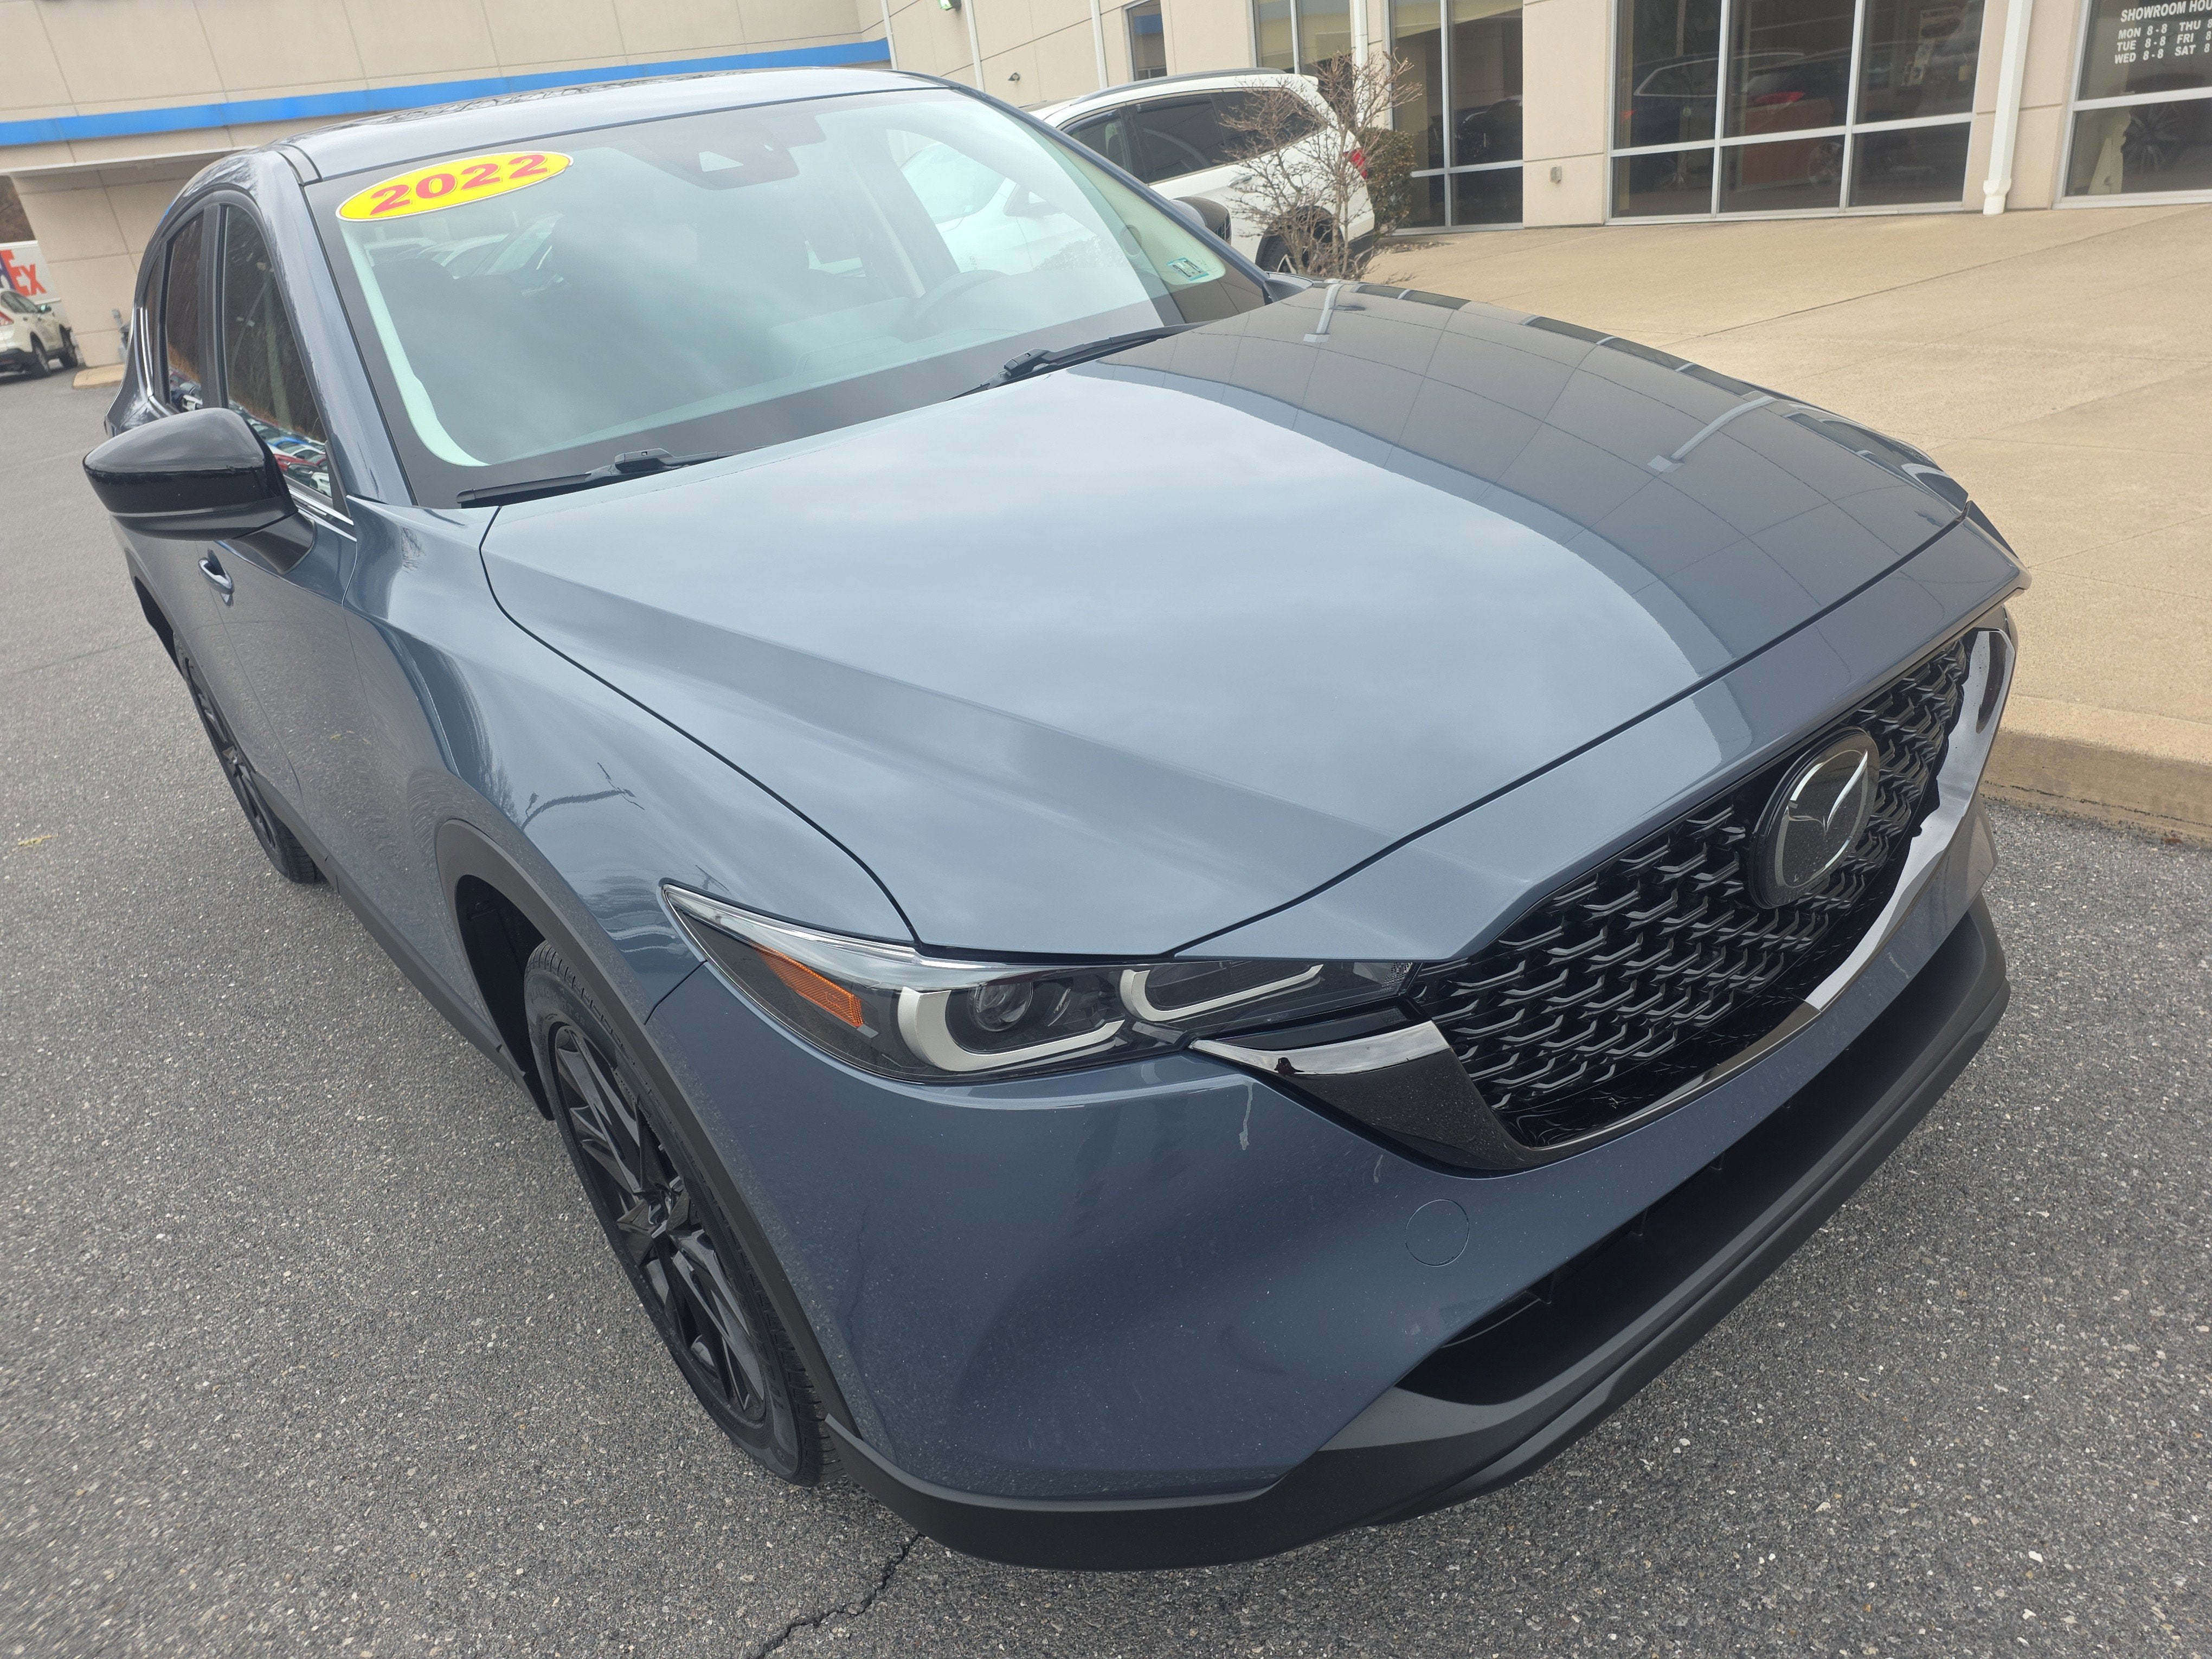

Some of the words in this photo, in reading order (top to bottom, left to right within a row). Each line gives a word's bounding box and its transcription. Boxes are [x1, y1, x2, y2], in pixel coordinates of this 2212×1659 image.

[2120, 1, 2187, 22] SHOWROOM
[2179, 20, 2201, 31] THU
[2118, 27, 2141, 40] MON
[2176, 33, 2194, 44] FRI
[2117, 40, 2137, 52] TUE
[2175, 44, 2196, 56] SAT
[2115, 52, 2137, 64] WED
[370, 154, 550, 216] 2022
